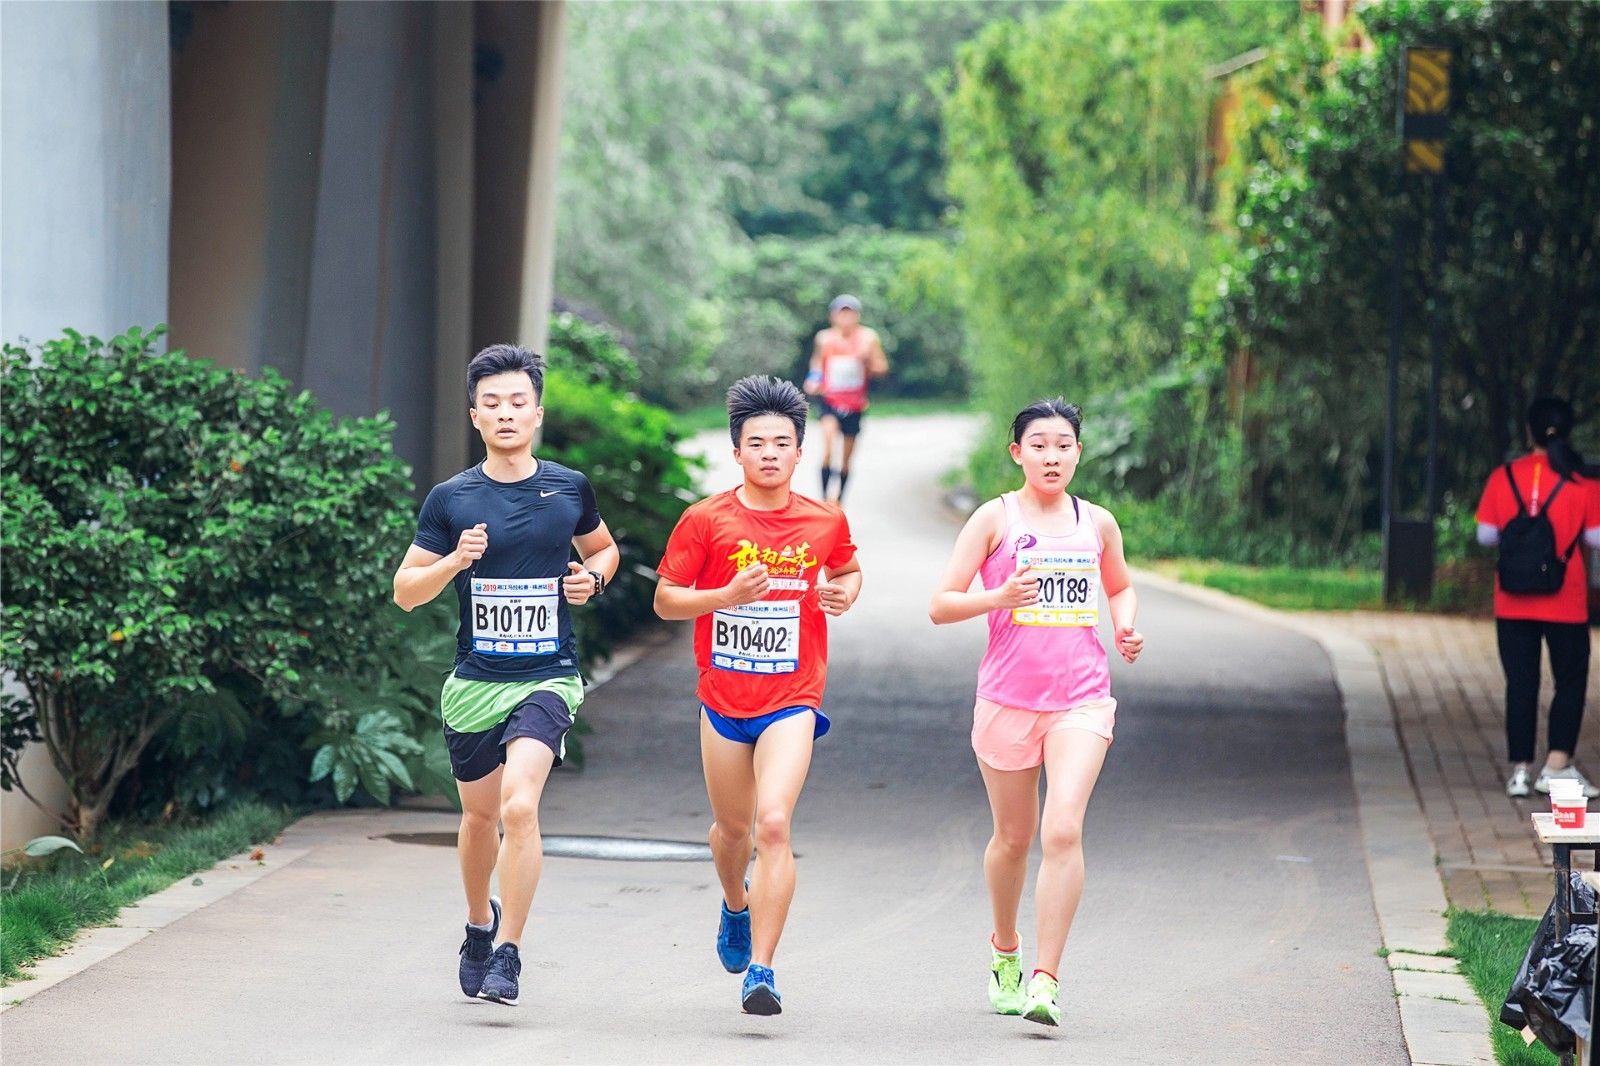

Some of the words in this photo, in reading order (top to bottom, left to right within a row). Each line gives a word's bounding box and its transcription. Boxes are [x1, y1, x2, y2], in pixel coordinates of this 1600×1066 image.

[483, 583, 497, 592] 2019
[476, 603, 547, 632] B10170
[716, 620, 787, 653] B10402
